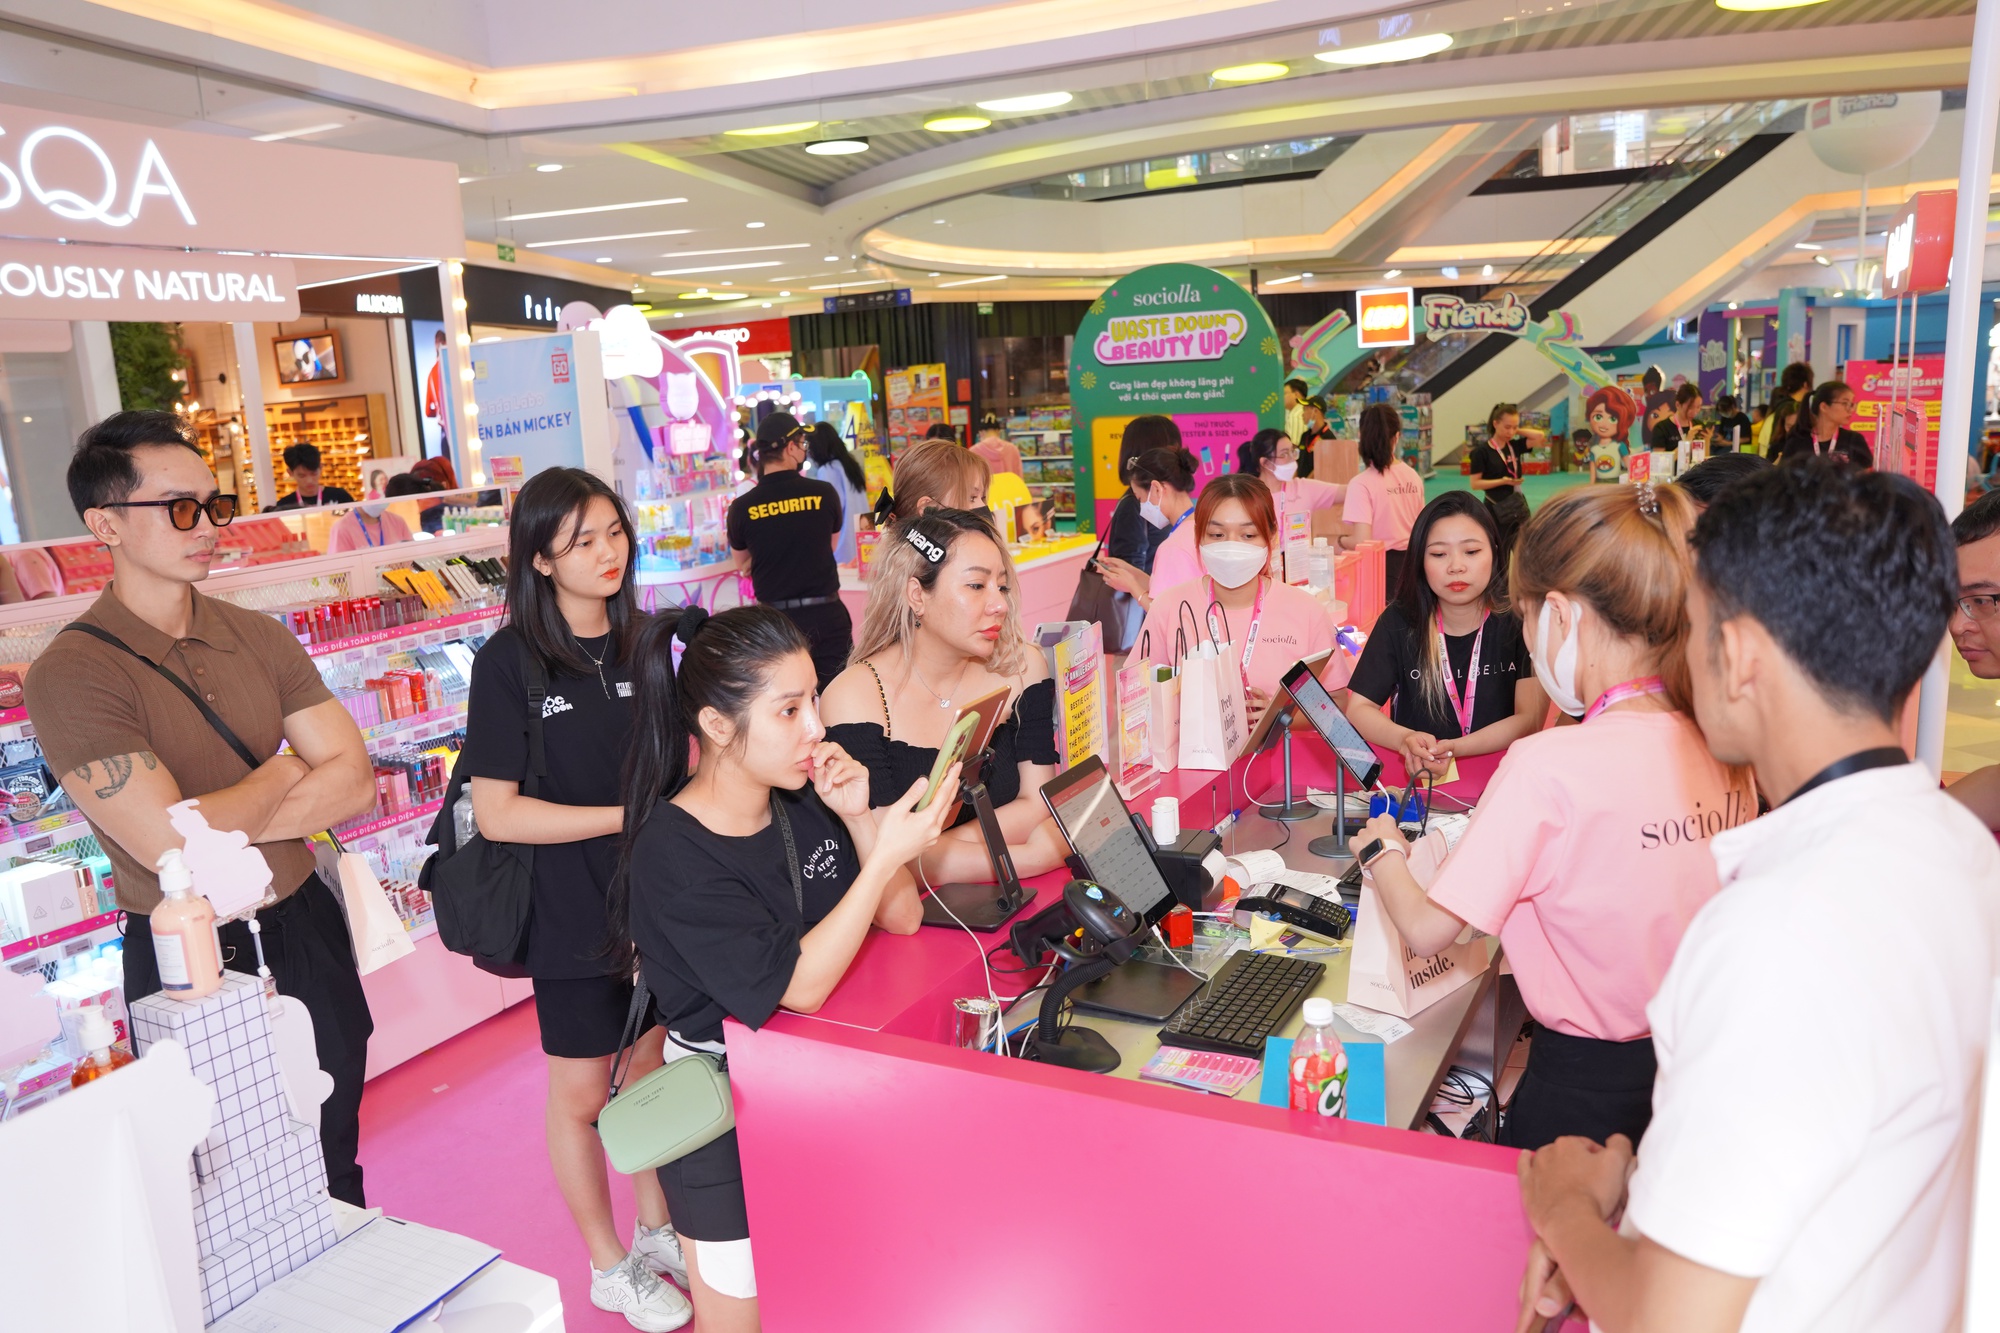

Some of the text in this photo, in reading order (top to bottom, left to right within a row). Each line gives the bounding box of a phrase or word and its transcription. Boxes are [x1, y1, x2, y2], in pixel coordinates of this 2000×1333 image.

[0, 263, 286, 302] OUSLY NATURAL
[1133, 284, 1201, 306] sociolla
[1361, 304, 1409, 331] LEGO
[1425, 292, 1530, 333] Friends
[1111, 313, 1228, 342] WASTE DOWN
[1112, 329, 1228, 361] BEAUTY UP
[553, 360, 569, 376] GO
[1109, 376, 1234, 393] Cùng làm đẹp không lãng phí
[1133, 393, 1140, 401] 4
[1161, 392, 1181, 402] quen
[524, 411, 572, 432] MICKEY
[845, 415, 857, 449] 4
[1386, 482, 1419, 495] sciolla
[748, 496, 823, 520] SECURITY
[906, 529, 945, 563] wang
[308, 644, 329, 656] RANG
[1262, 635, 1297, 645] sociolla
[338, 831, 358, 843] RANG
[1409, 953, 1455, 990] inside.
